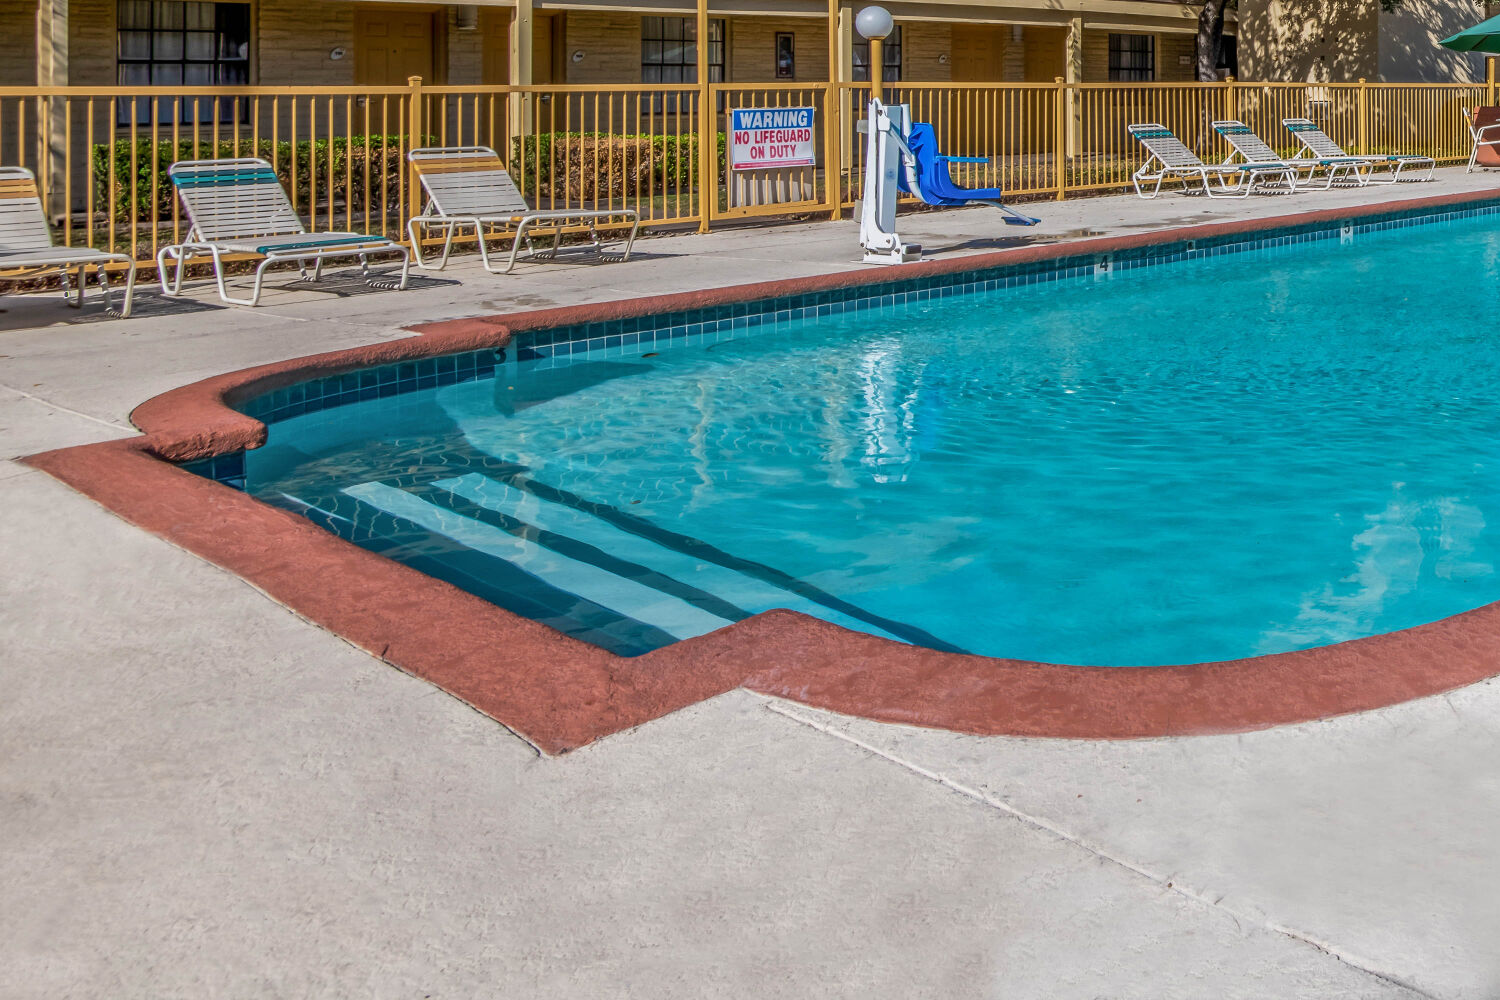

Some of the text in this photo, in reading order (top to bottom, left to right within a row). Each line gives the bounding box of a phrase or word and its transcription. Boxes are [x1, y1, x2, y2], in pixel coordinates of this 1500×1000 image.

[740, 110, 808, 129] WARNING
[734, 129, 811, 145] NO LIFEGUARD
[750, 144, 797, 160] ON DUTY
[1099, 254, 1109, 272] 4
